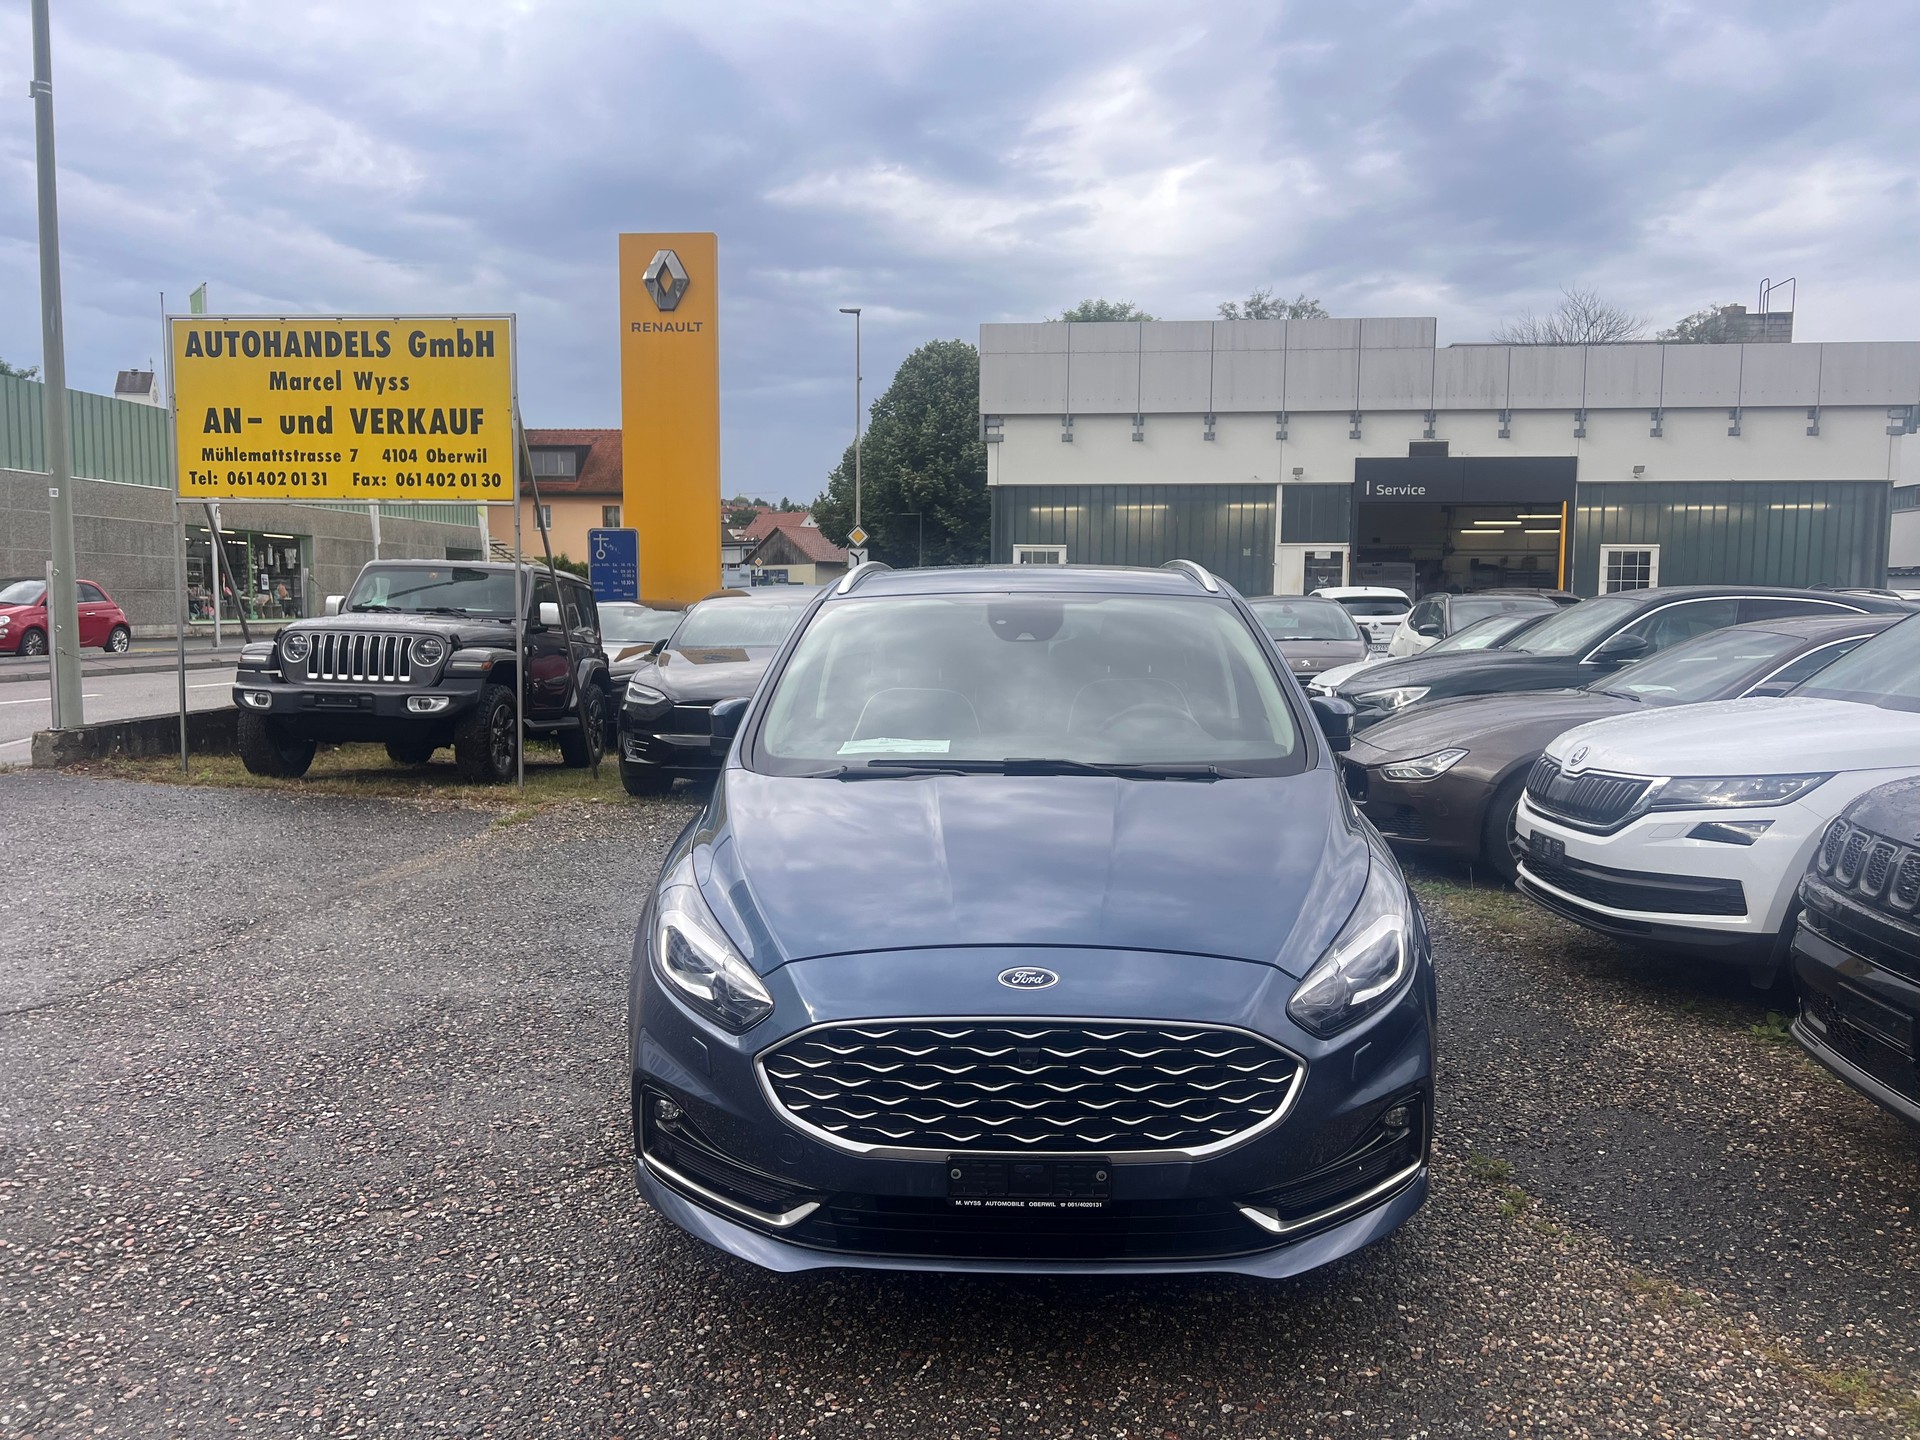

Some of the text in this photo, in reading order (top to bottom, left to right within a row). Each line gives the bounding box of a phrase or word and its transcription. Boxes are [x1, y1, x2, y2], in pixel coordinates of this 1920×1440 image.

[631, 322, 703, 333] RENAULT
[185, 328, 494, 358] AUTOHANDELS GmbH
[269, 370, 410, 395] Marcel Wyss
[279, 405, 332, 434] und
[350, 408, 483, 435] VERKAUF
[201, 447, 487, 463] Mühlemattstrasse 7 4104 Oberwil
[189, 470, 217, 485] Tel:
[353, 472, 386, 487] Fax:
[1376, 484, 1426, 496] Service
[1011, 971, 1044, 984] Ford
